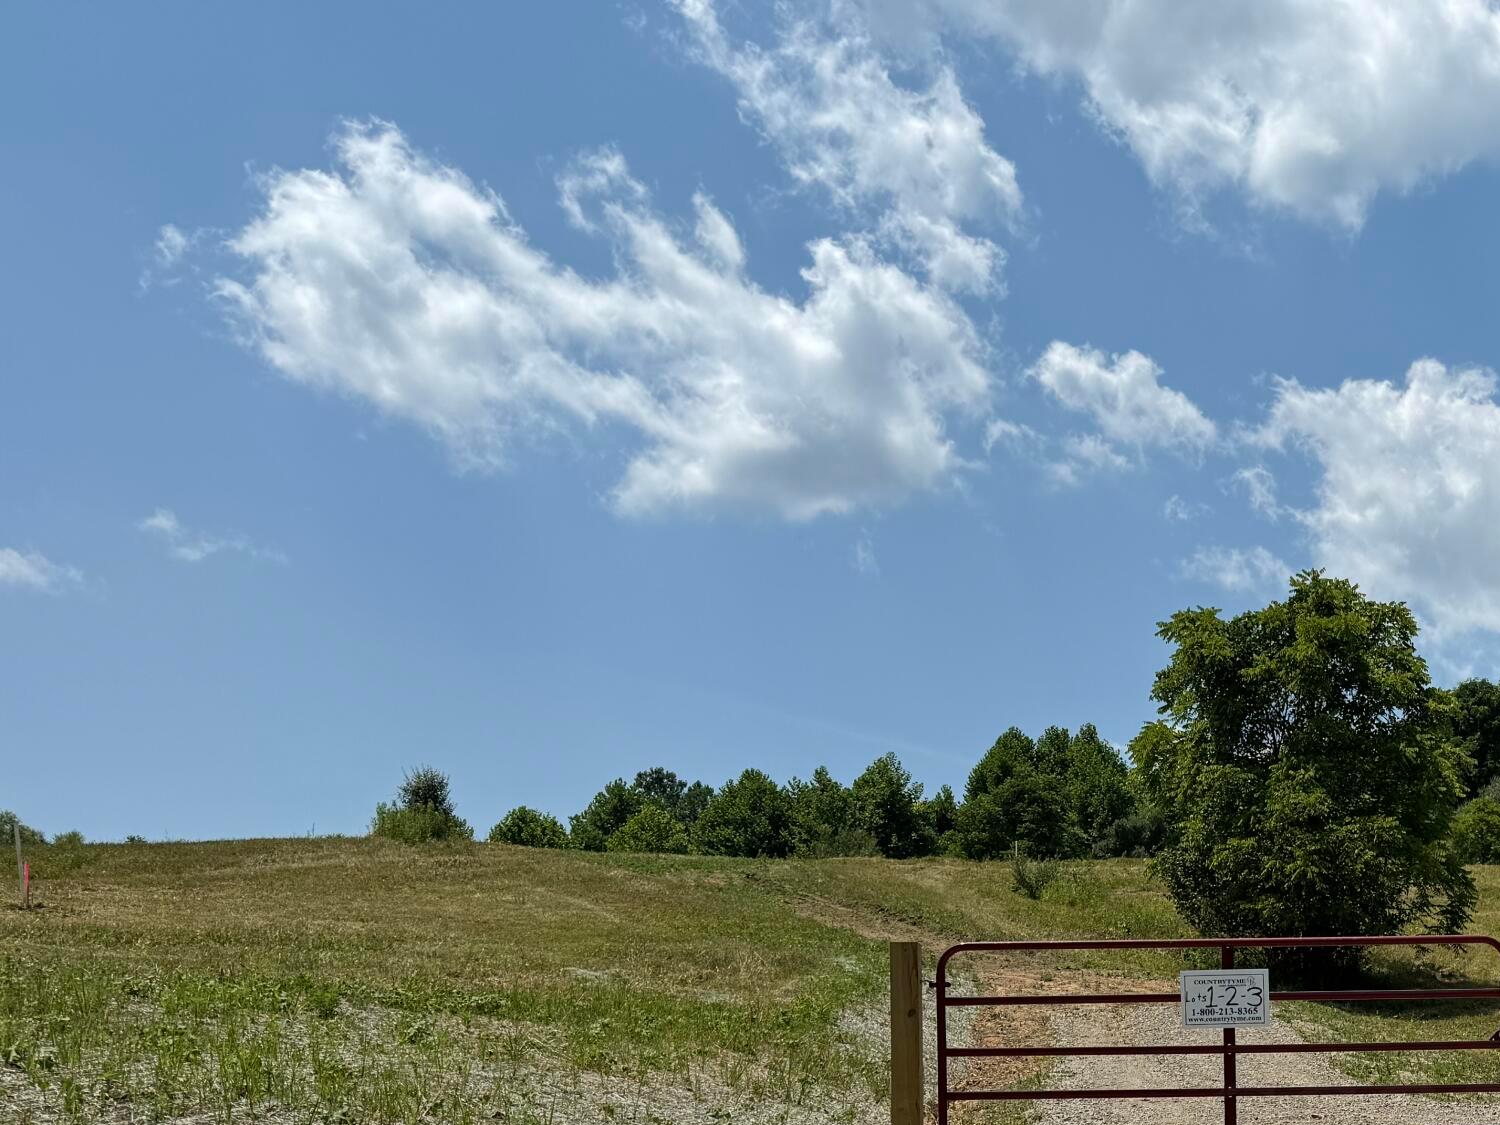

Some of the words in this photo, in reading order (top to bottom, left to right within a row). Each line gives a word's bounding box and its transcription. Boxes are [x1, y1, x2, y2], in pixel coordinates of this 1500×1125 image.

[1185, 991, 1207, 1003] Lots
[1205, 986, 1262, 1007] 1-2-3
[1192, 1007, 1258, 1016] 1-800-213-8365
